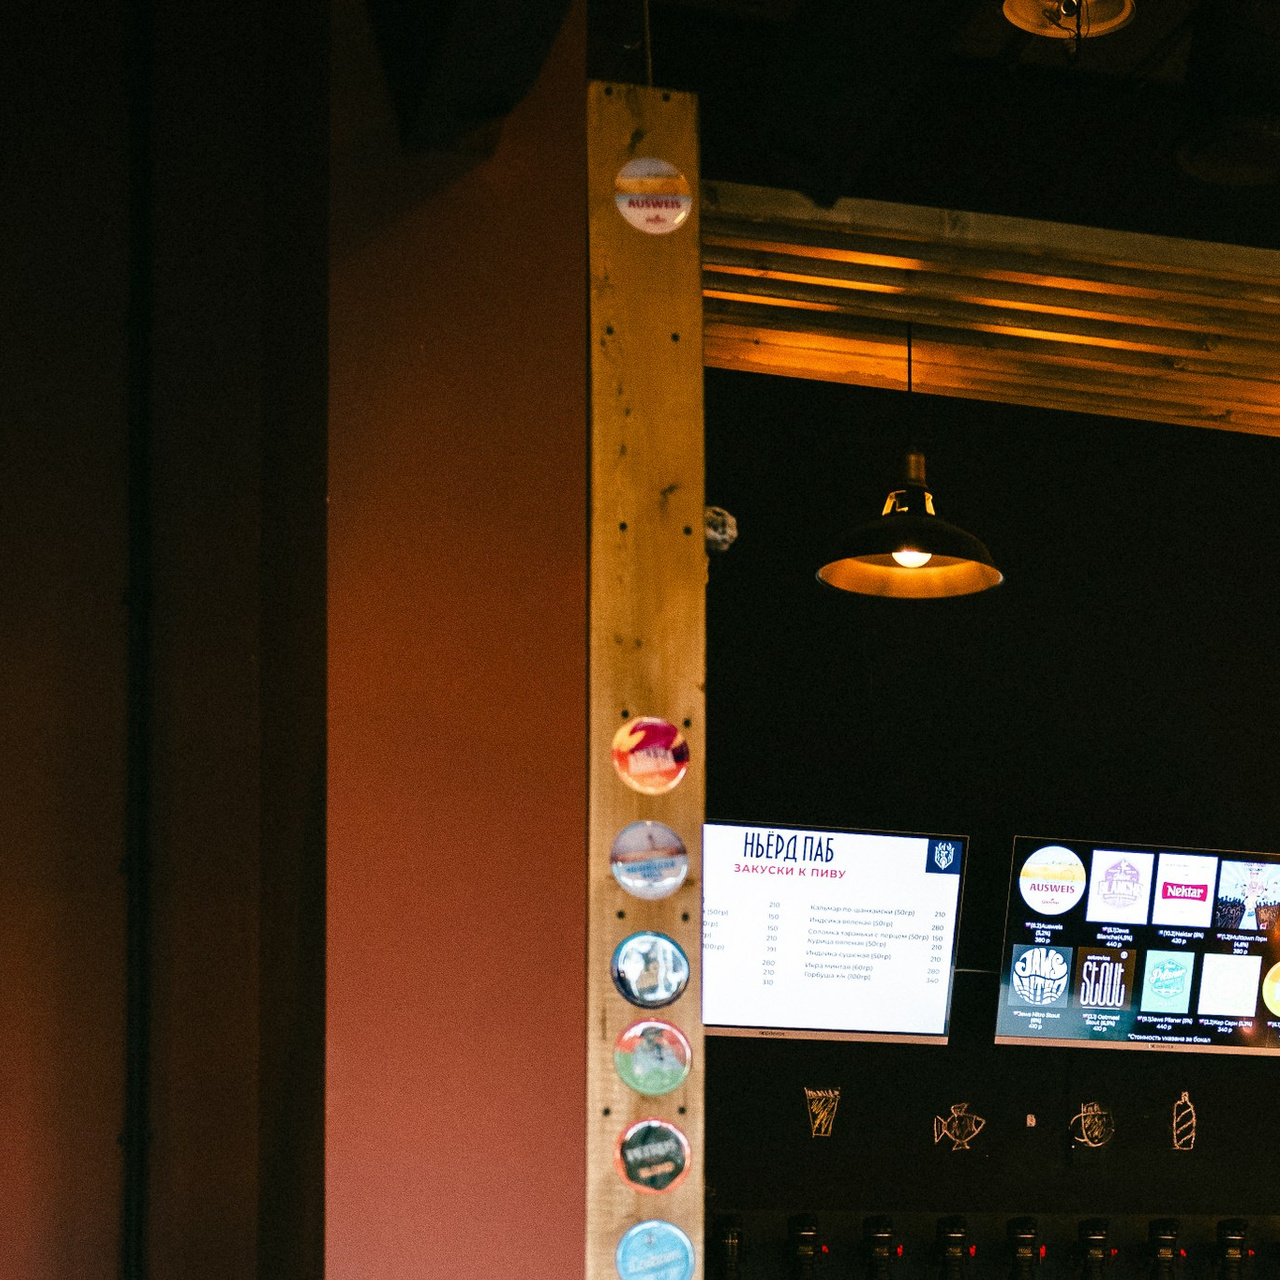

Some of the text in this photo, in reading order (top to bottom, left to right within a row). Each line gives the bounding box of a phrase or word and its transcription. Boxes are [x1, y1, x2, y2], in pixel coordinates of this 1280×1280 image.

[744, 831, 834, 863] НЬЁРД ПАБ
[734, 864, 846, 879] ЗАКУСКИ К ПИВУ
[1030, 883, 1075, 894] AUSWEIS
[1166, 885, 1204, 899] Nektar
